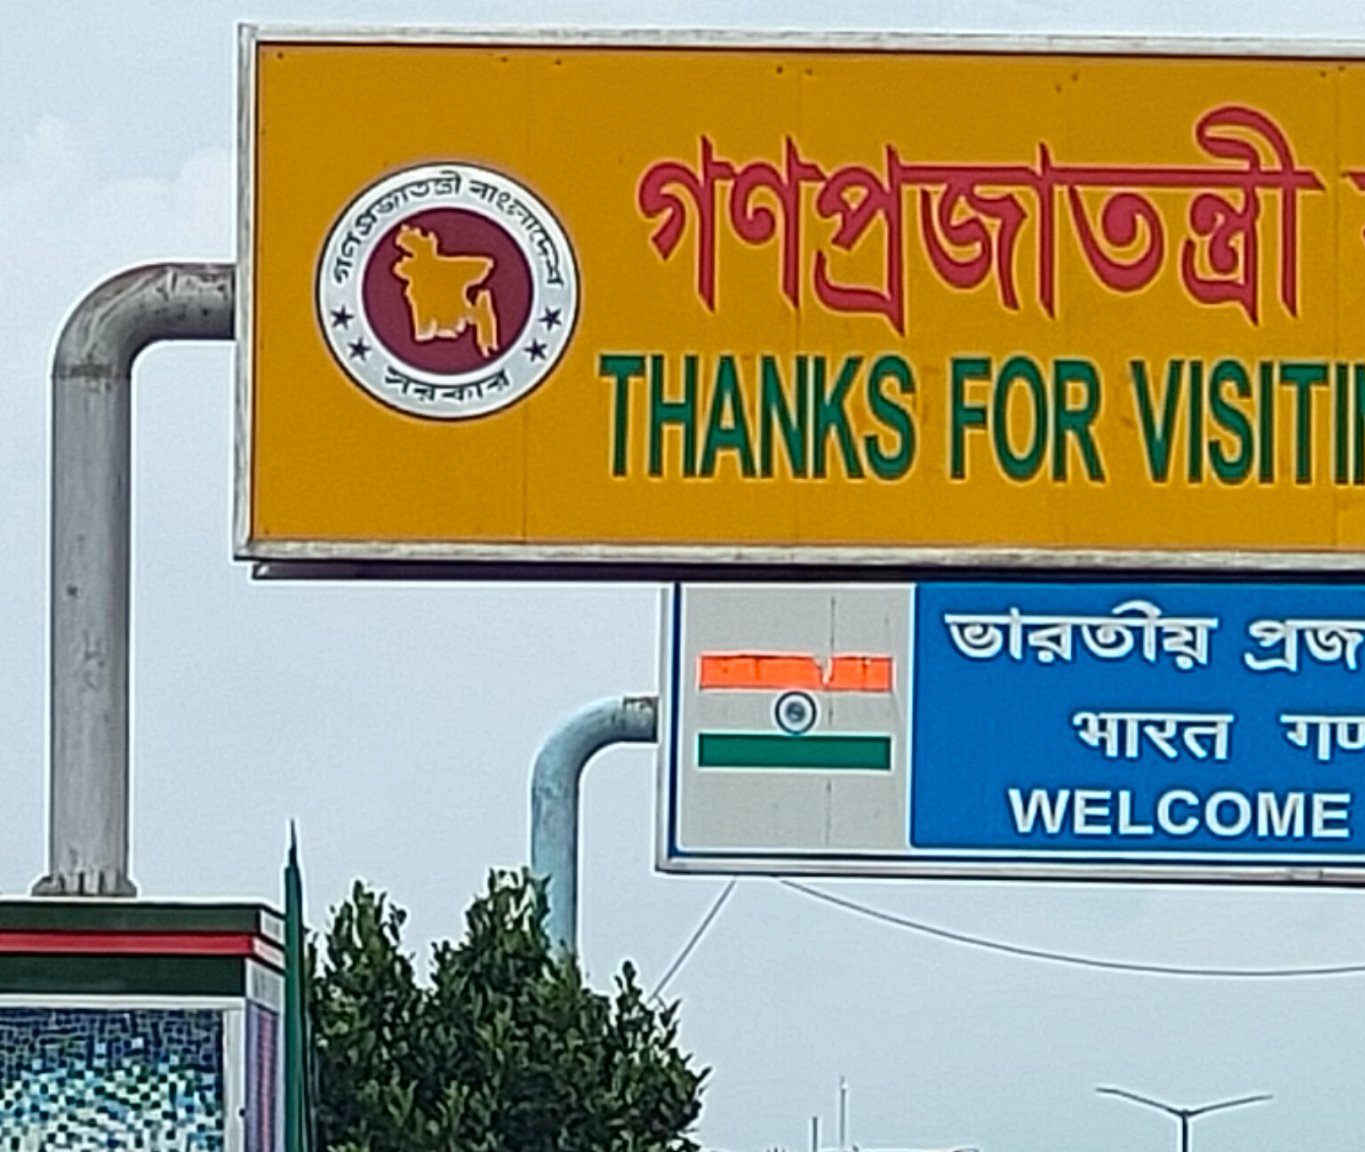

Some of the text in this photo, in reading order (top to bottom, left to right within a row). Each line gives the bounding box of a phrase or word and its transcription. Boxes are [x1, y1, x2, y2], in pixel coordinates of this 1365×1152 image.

[637, 104, 1324, 336] গণপ্রজাতন্ত্রী
[600, 355, 913, 478] THANKS
[951, 357, 1102, 482] FOR
[944, 600, 1218, 669] ভারতীয়
[1072, 711, 1234, 760] भारत
[1008, 788, 1352, 838] WELCOME
